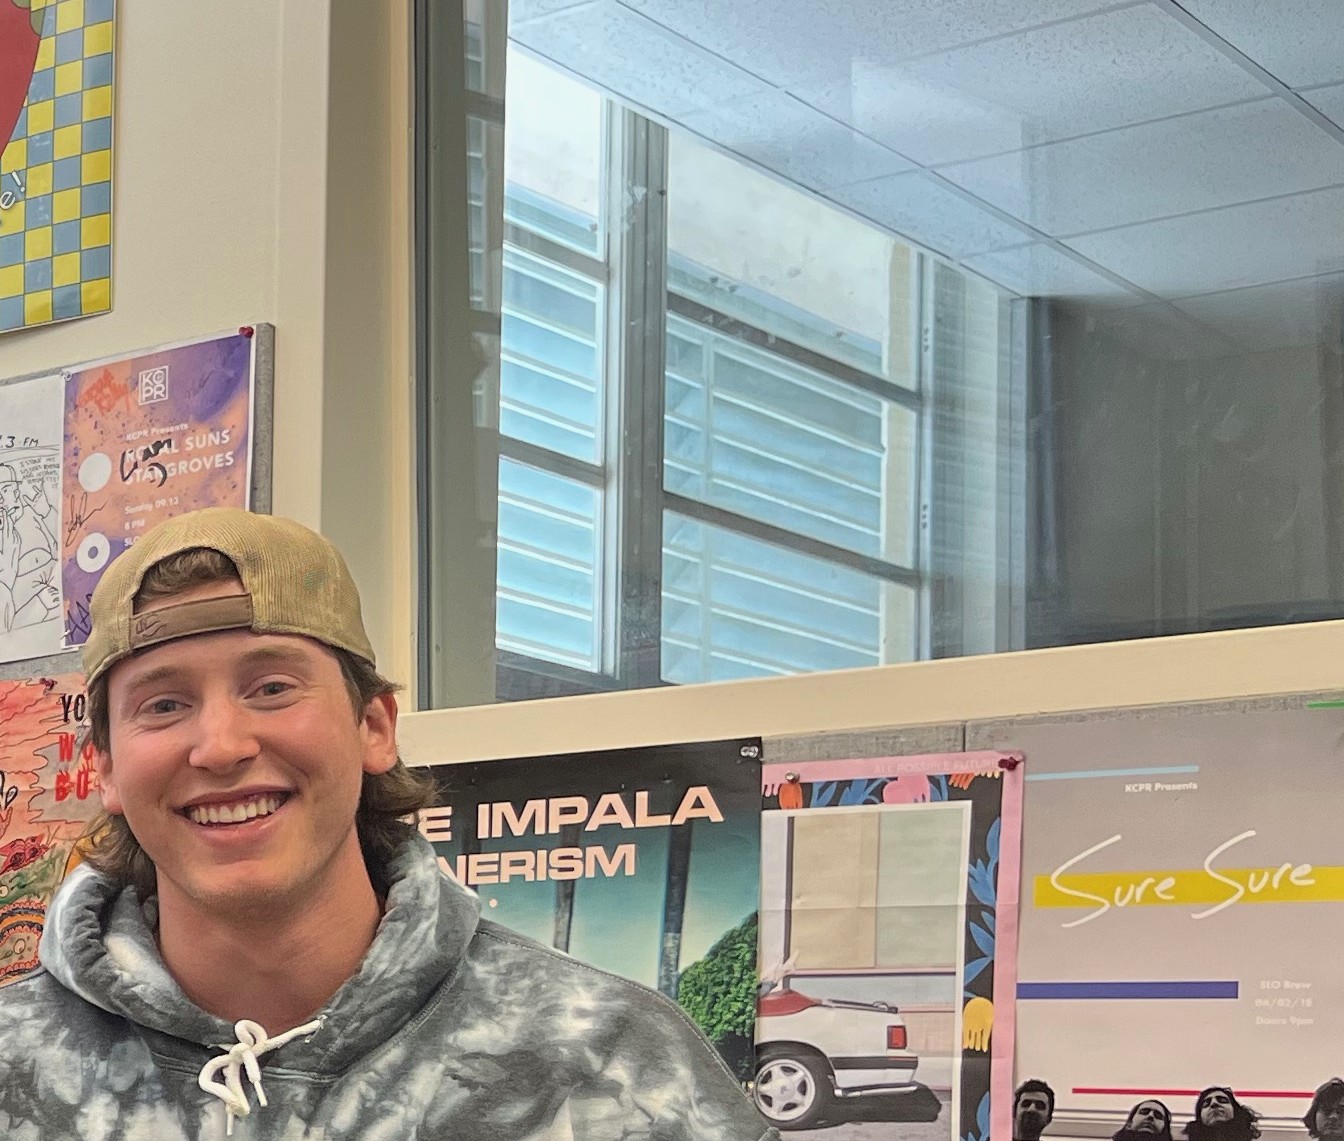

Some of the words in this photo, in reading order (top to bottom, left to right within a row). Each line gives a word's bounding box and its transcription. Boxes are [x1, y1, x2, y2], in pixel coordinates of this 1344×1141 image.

[23, 437, 38, 447] FM
[185, 429, 230, 451] SUNS
[1124, 783, 1151, 793] KCPR
[1154, 781, 1199, 792] Presents
[477, 785, 725, 839] IMPALA
[437, 844, 636, 887] NERISM
[1050, 834, 1176, 928] Sure
[1191, 829, 1316, 920] Sure
